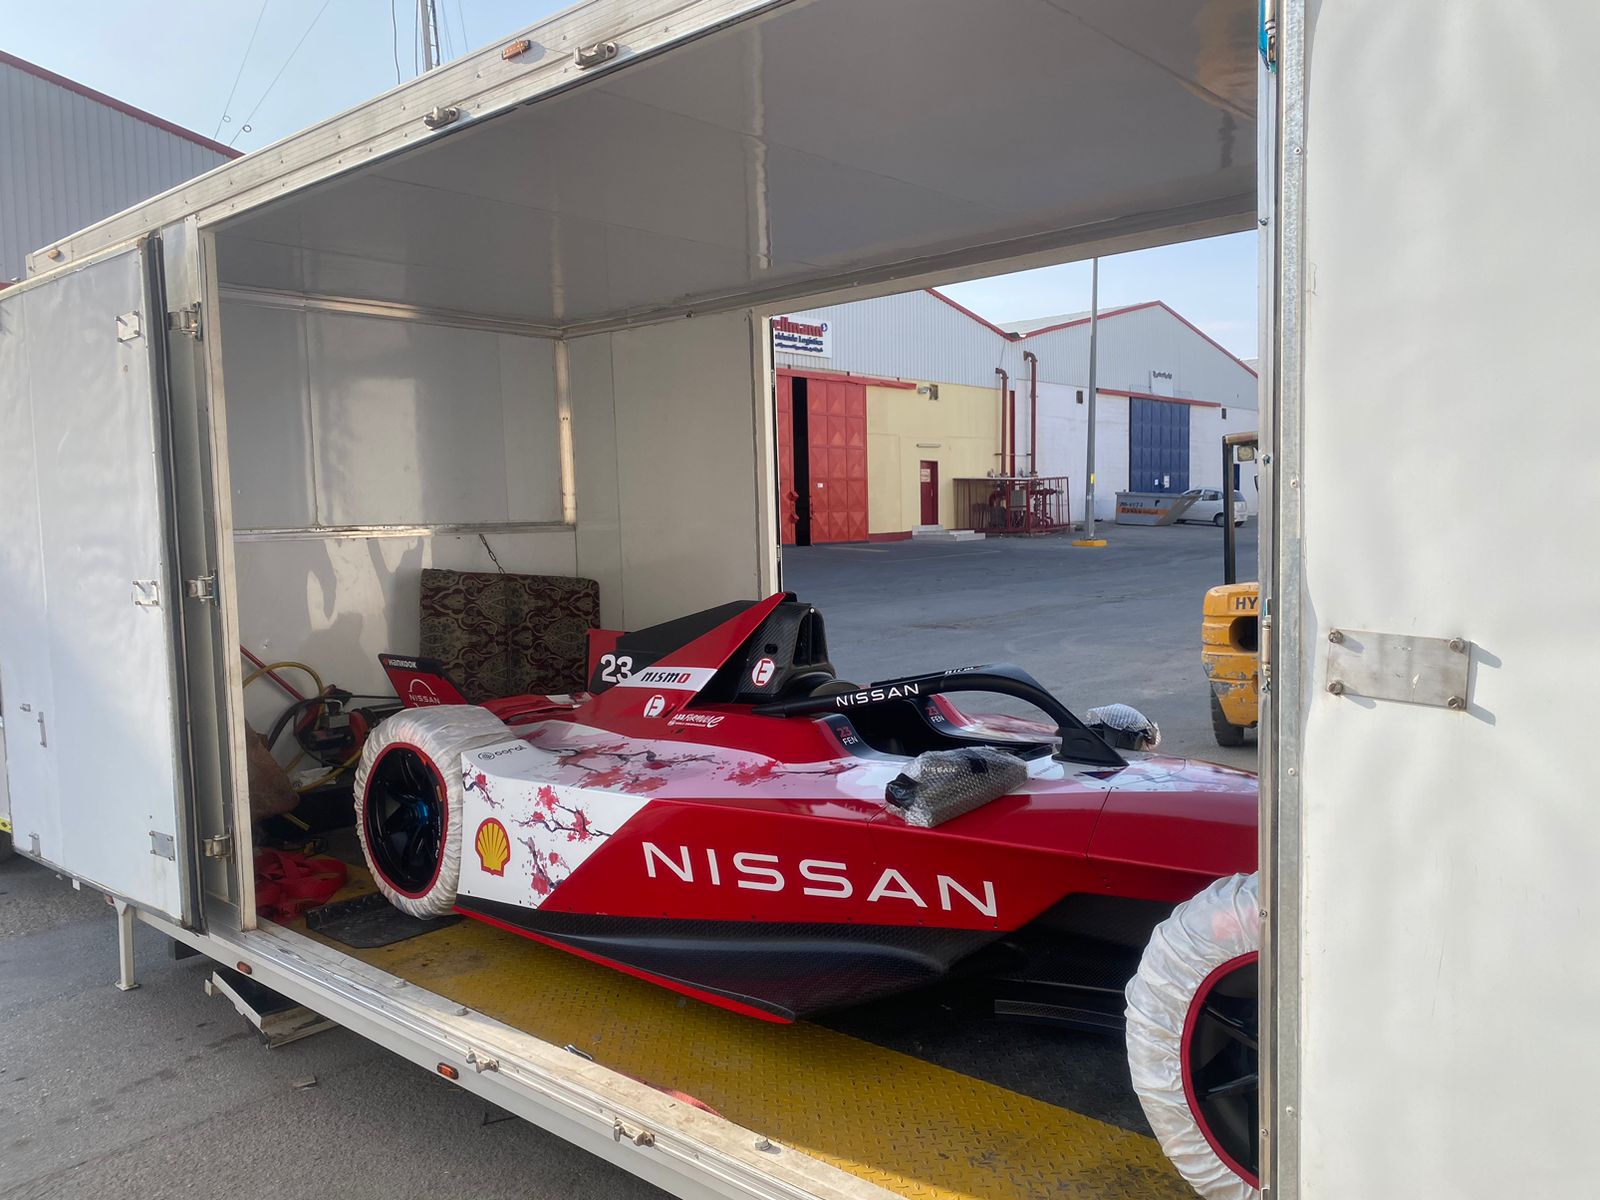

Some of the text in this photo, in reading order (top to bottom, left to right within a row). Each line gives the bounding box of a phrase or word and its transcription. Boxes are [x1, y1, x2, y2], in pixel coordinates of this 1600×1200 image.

[600, 654, 633, 684] 23
[409, 694, 440, 704] NISSAN
[836, 683, 920, 707] NISSAN
[836, 726, 852, 738] 23
[842, 735, 858, 746] FEN
[641, 841, 998, 917] NISSAN
